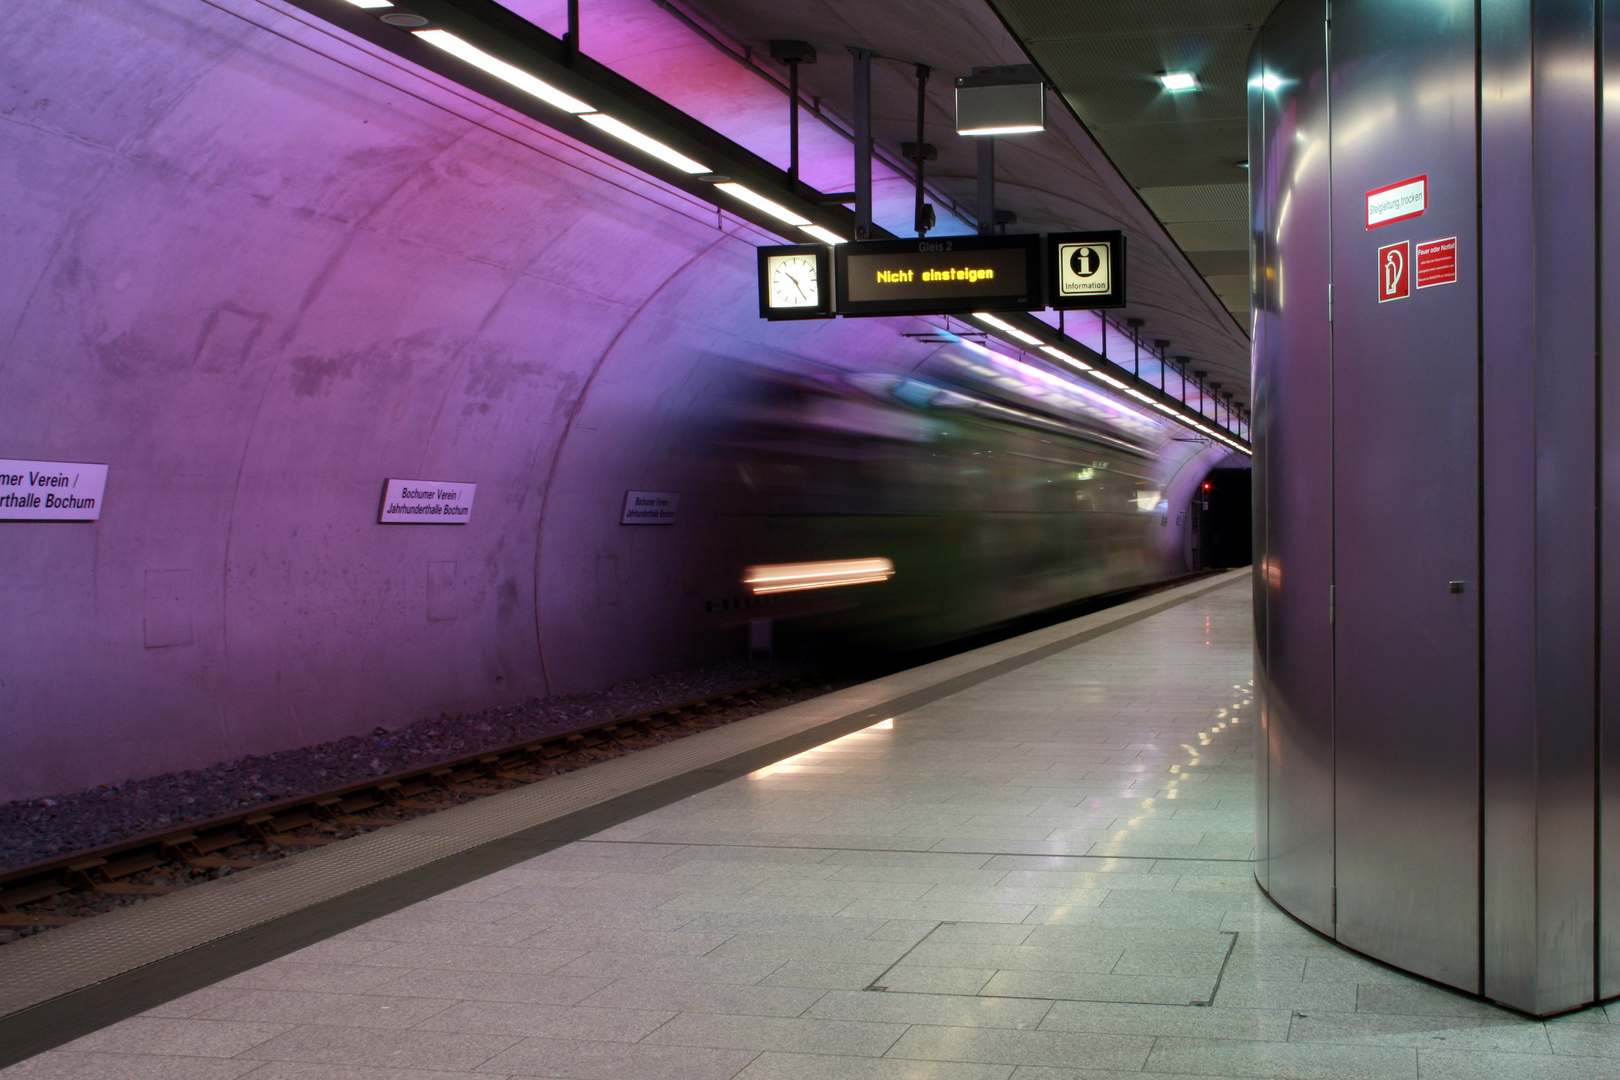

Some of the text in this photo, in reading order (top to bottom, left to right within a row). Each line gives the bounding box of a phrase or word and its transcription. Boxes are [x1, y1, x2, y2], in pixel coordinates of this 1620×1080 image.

[1401, 192, 1422, 206] trocken
[918, 241, 953, 252] Gleis 2
[876, 267, 994, 283] Nicht einsteigen
[1065, 282, 1106, 290] Information
[30, 471, 69, 488] Verein
[45, 493, 95, 509] Bochum
[401, 487, 435, 500] Bochumer
[437, 489, 457, 501] Verein
[387, 503, 468, 515] Jahrhunderthalle Bochum
